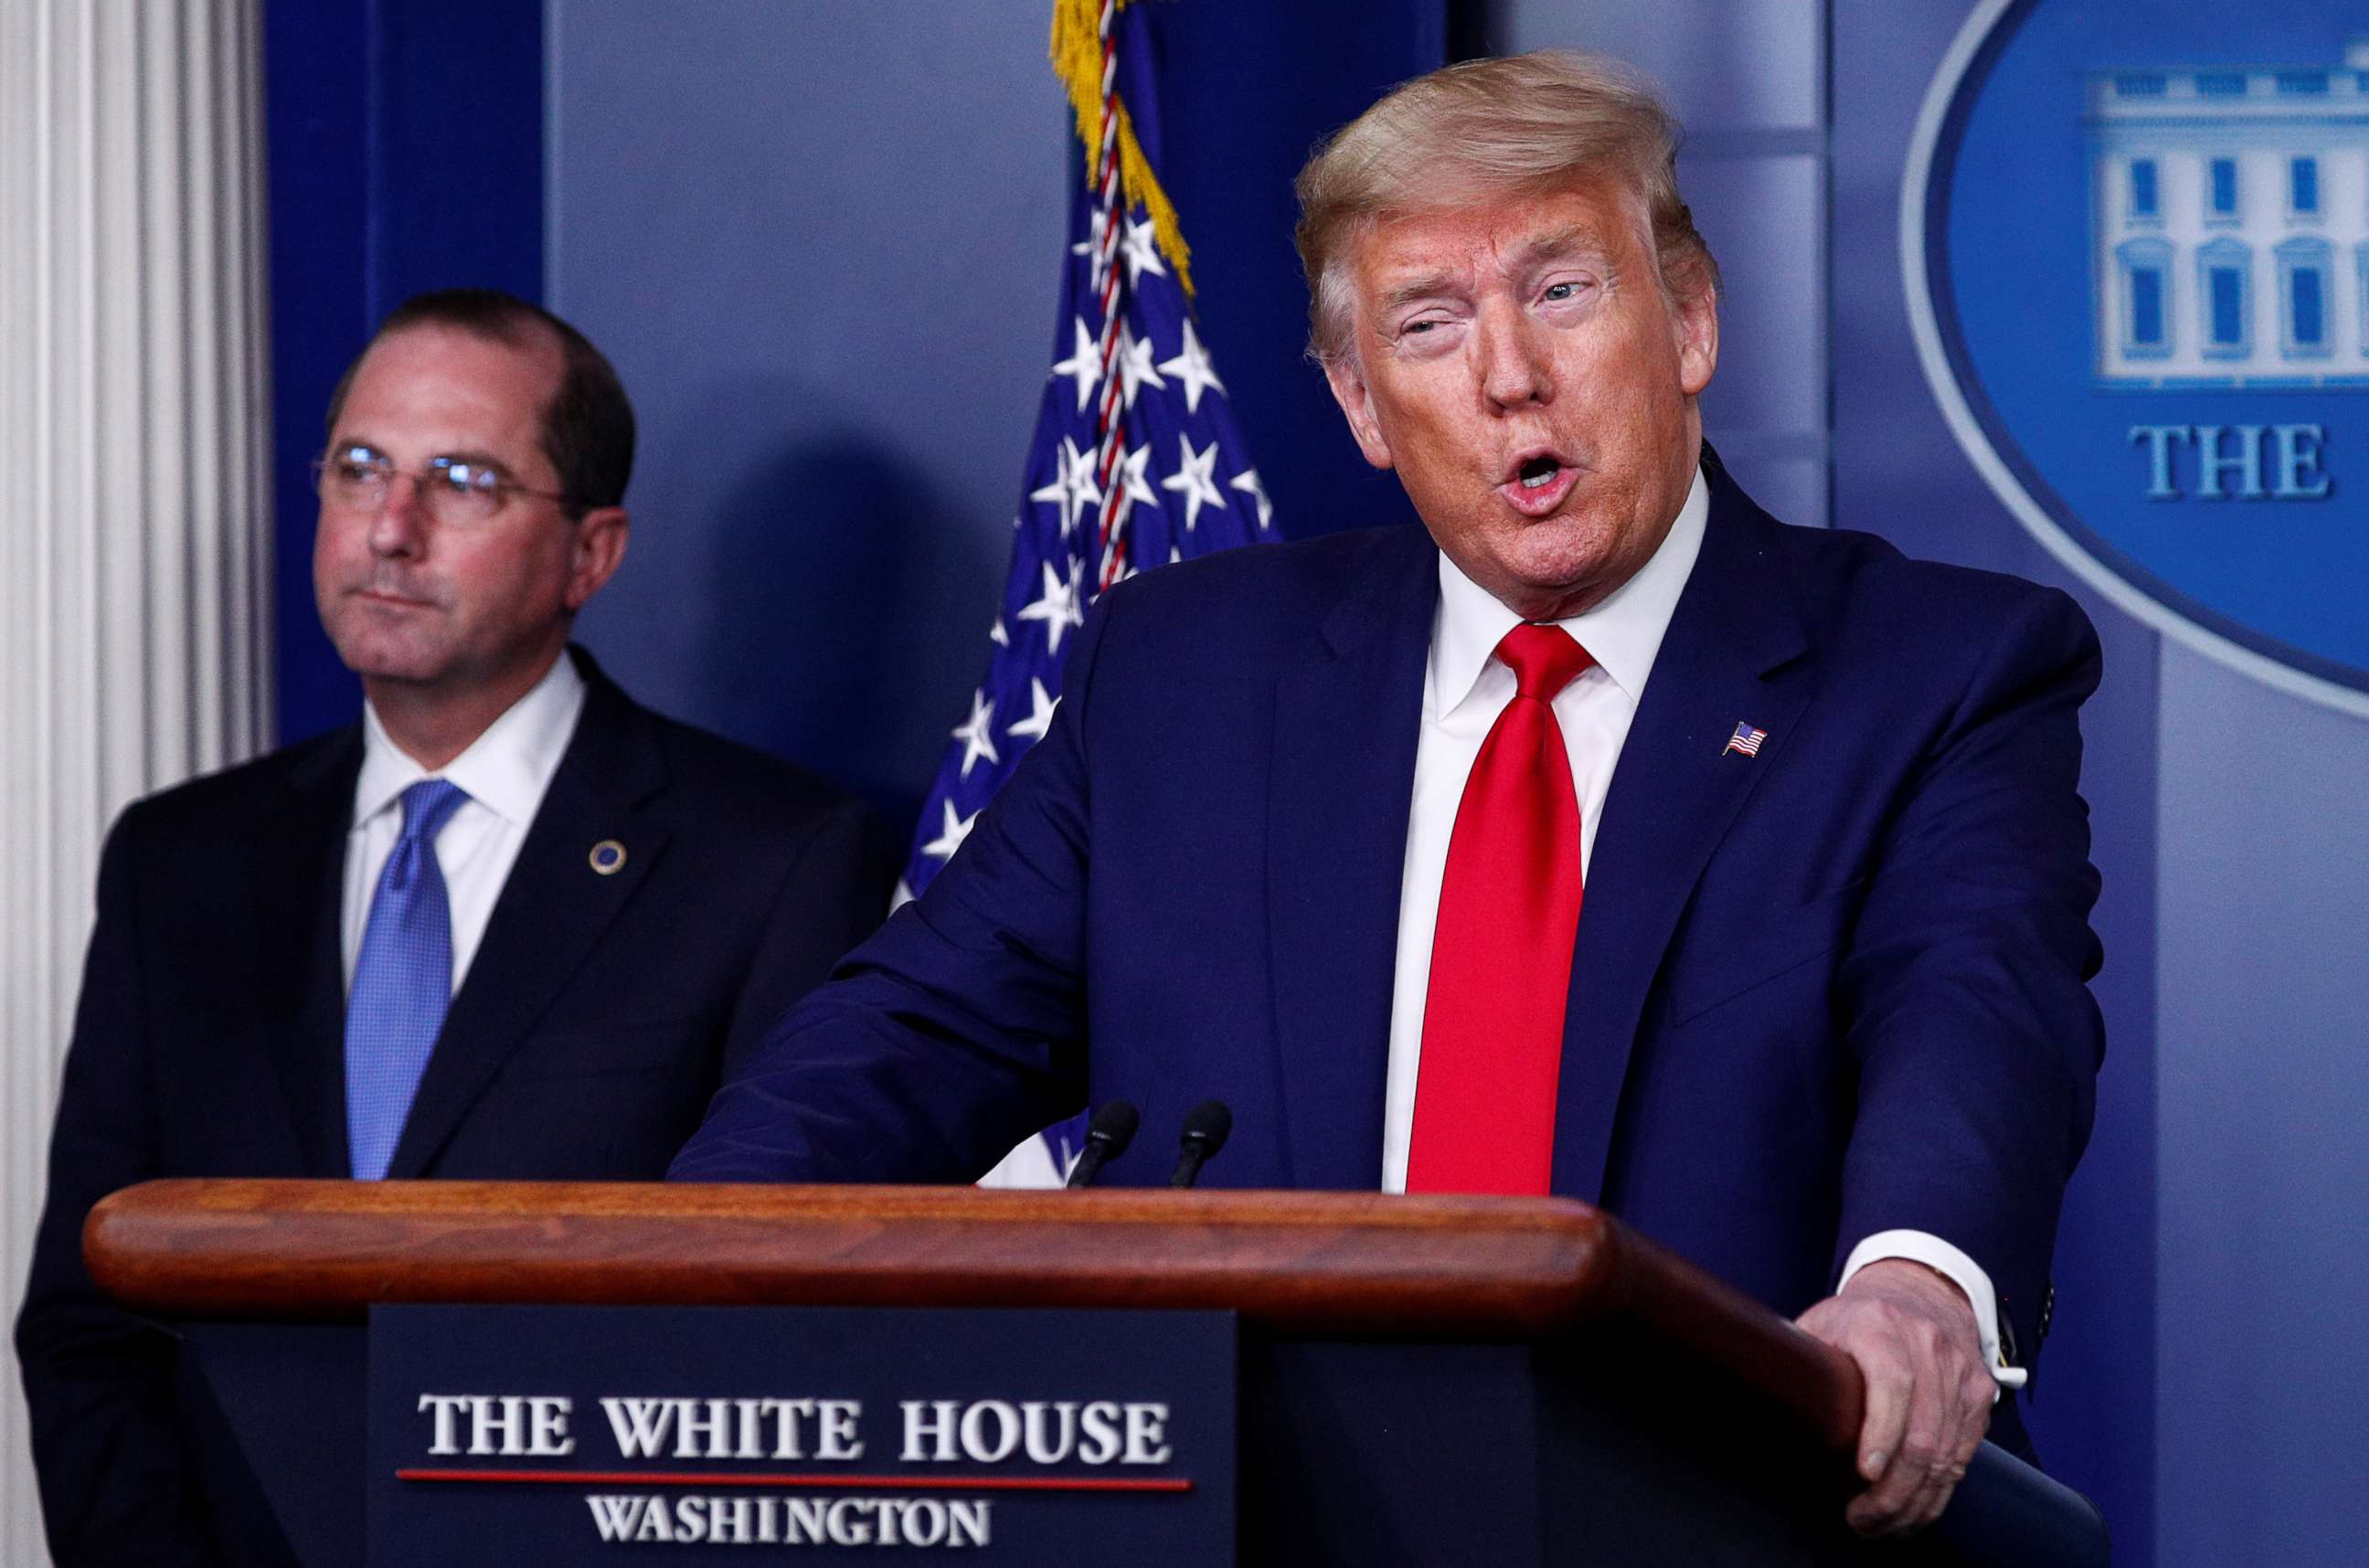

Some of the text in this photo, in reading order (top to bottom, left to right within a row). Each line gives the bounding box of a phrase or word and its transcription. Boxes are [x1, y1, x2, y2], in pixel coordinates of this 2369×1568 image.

[2128, 424, 2330, 498] THE
[418, 1393, 1172, 1465] THE WHITE HOUSE
[586, 1495, 991, 1547] WASHINGTON
